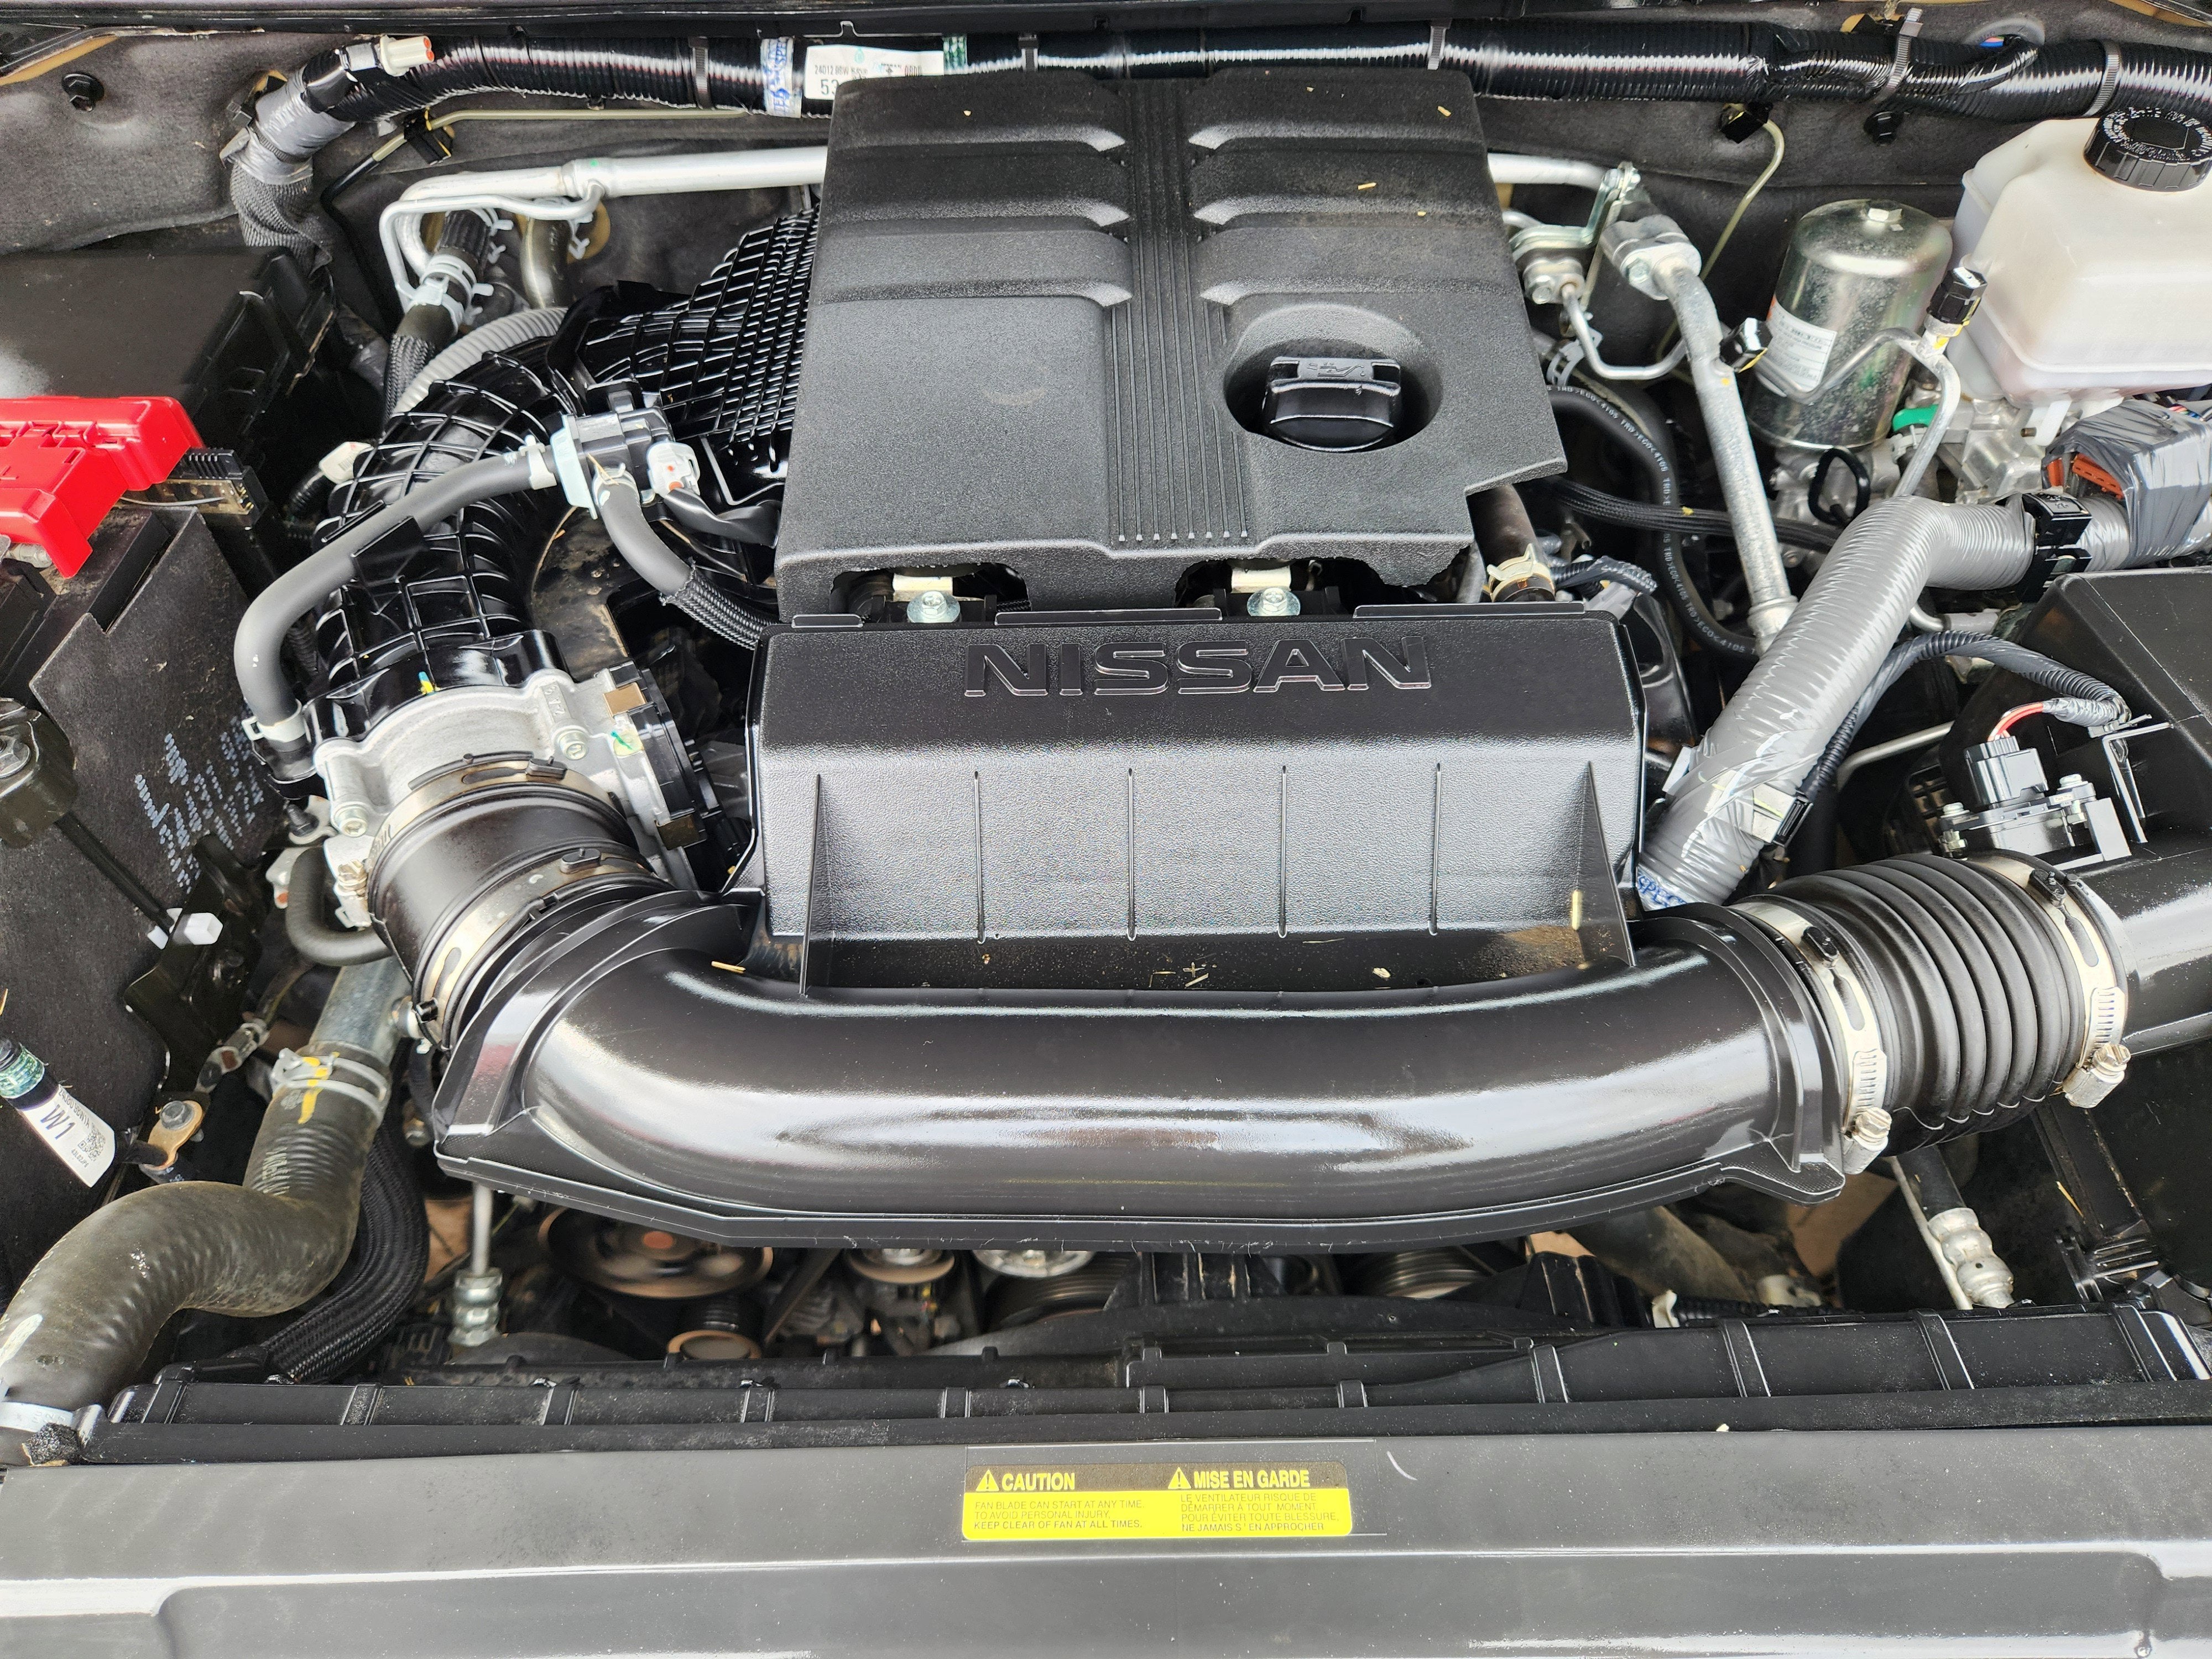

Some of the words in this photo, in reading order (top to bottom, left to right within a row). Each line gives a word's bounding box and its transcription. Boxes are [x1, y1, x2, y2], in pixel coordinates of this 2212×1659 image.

[964, 636, 1432, 697] NISSAN
[40, 1103, 76, 1140] W1
[1001, 1473, 1075, 1491] CAUTION
[1193, 1471, 1230, 1489] MISE
[1233, 1470, 1254, 1488] EN
[1257, 1469, 1311, 1488] GARDE
[1181, 1494, 1192, 1503] LE
[1194, 1493, 1260, 1503] VENTILATEUR
[1264, 1493, 1300, 1501] RISQUE
[1303, 1493, 1317, 1501] DE
[975, 1501, 993, 1510] FAN
[997, 1501, 1026, 1510] BLADE
[1029, 1501, 1050, 1509] CAN
[1052, 1500, 1083, 1509] START
[1084, 1500, 1095, 1509] AT
[1098, 1500, 1117, 1509] ANY
[1119, 1499, 1145, 1509] TIME.
[1246, 1503, 1271, 1511] TOUT
[974, 1511, 987, 1520] TO
[989, 1511, 1018, 1520] AVOID
[1021, 1510, 1073, 1519] PERSONAL
[1075, 1510, 1111, 1519] INJURY,
[1182, 1513, 1208, 1522] POUR
[1248, 1512, 1282, 1521] TOUTE
[1285, 1512, 1339, 1521] BLESSURE,
[974, 1521, 1000, 1530] KEEP
[1002, 1521, 1035, 1529] CLEAR
[1110, 1520, 1142, 1528] TIMES.
[1182, 1524, 1195, 1532] NE
[1197, 1523, 1233, 1532] JAMAIS
[1249, 1523, 1261, 1531] EN
